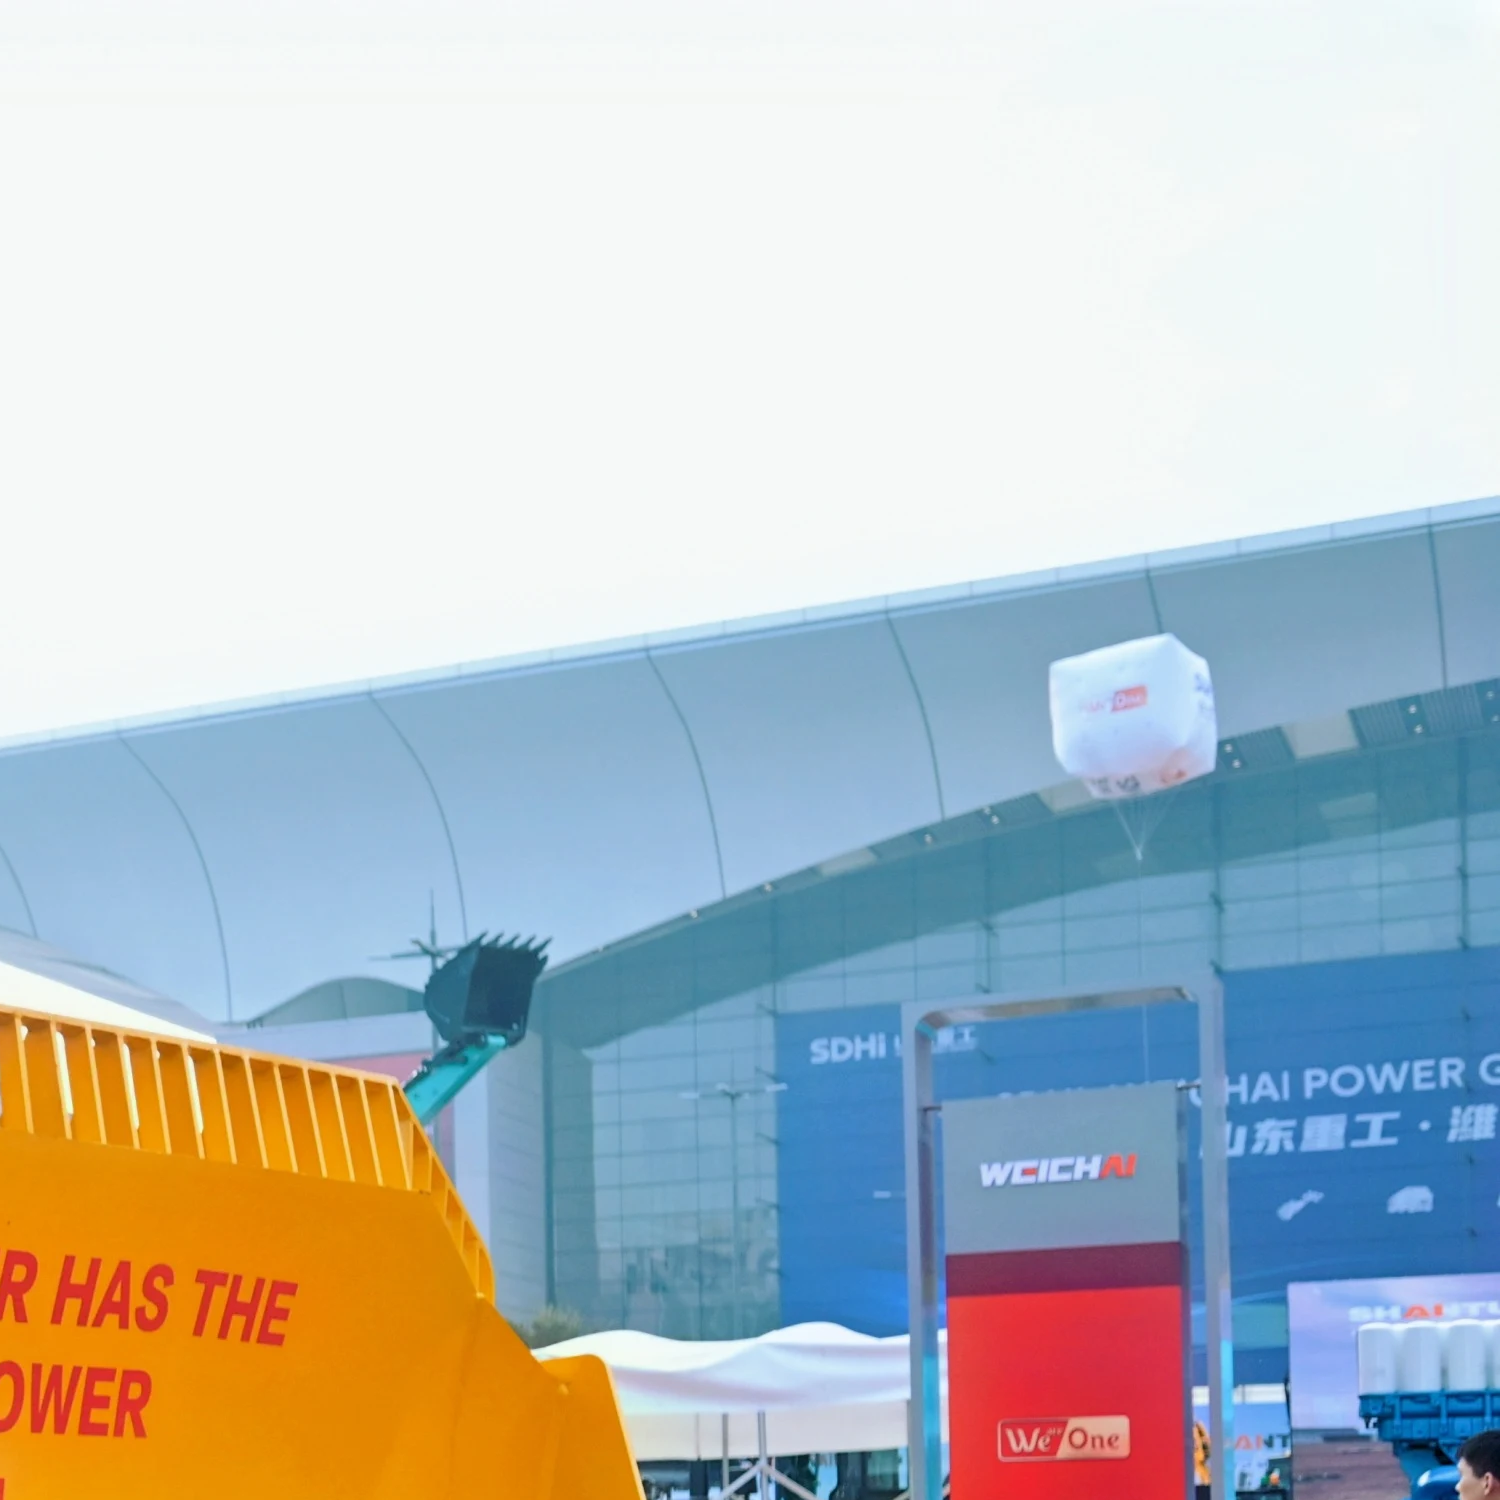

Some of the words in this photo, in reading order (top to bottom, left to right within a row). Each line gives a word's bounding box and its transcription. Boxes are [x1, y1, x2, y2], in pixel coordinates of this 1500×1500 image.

[1302, 1057, 1466, 1100] POWER
[979, 1152, 1138, 1189] WEICHAI
[50, 1254, 175, 1333] HAS
[192, 1268, 298, 1347] THE
[1005, 1427, 1051, 1453] We
[1068, 1427, 1120, 1450] One
